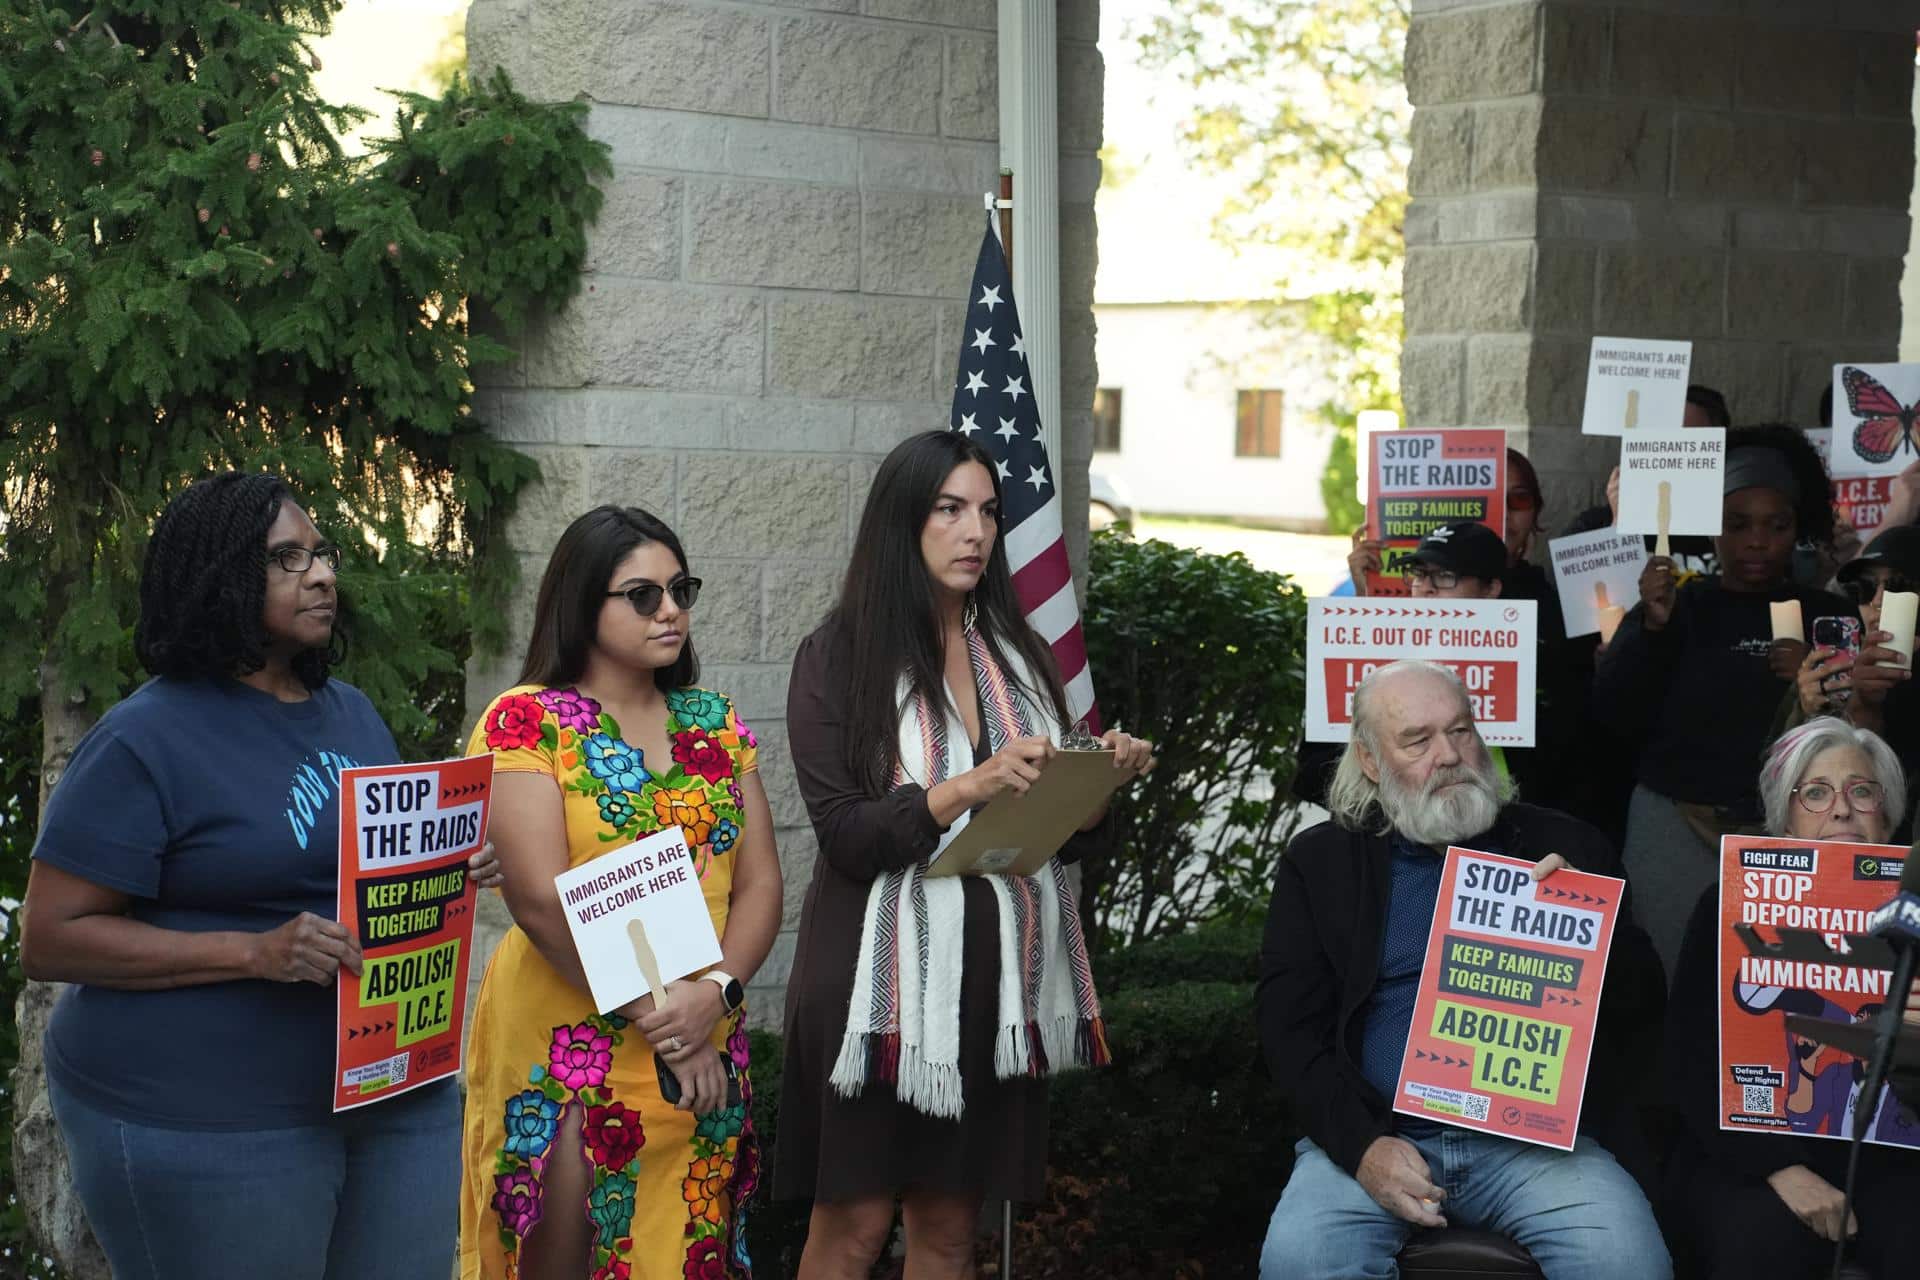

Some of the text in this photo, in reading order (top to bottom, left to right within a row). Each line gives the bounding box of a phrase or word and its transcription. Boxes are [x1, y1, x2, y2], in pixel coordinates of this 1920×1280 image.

[1595, 350, 1688, 365] IMMIGRANTS ARE
[1598, 365, 1681, 379] WELCOME HERE
[1385, 438, 1435, 459] STOP
[1626, 441, 1722, 453] IMMIGRANTS ARE
[1383, 464, 1491, 486] THE RAIDS
[1629, 457, 1717, 470] WELCOME HERE
[1385, 502, 1482, 517] KEEP FAMILIES
[1385, 521, 1448, 536] TOGETH
[1555, 534, 1641, 562] IMMIGRANTS ARE
[1562, 550, 1640, 576] WELCOME HERE
[1324, 626, 1518, 648] I.C.E. OUT OF CHICAGO
[1466, 665, 1495, 690] OF
[365, 779, 431, 815] STOP
[363, 811, 478, 859] THE RAIDS
[565, 843, 686, 906] IMMIGRANTS ARE
[1744, 852, 1808, 868] FIGHT FEAR
[367, 870, 464, 909] KEEP FAMILIES
[577, 867, 687, 924] WELCOME HERE
[1464, 863, 1530, 897] STOP
[1744, 871, 1812, 902] STOP
[367, 905, 440, 939] TOGETHER
[1457, 895, 1595, 945] THE RAIDS
[1743, 902, 1877, 934] DEPORTATIO
[366, 945, 453, 1001] ABOLISH
[1451, 943, 1574, 984] KEEP FAMILIES
[1448, 968, 1534, 1001] TOGETHER
[403, 990, 447, 1035] I.C.E.
[1438, 1006, 1562, 1057] ABOLISH
[1481, 1052, 1551, 1094] I.C.E.
[1735, 1067, 1763, 1075] Defend
[1736, 1075, 1780, 1085] Your Rights
